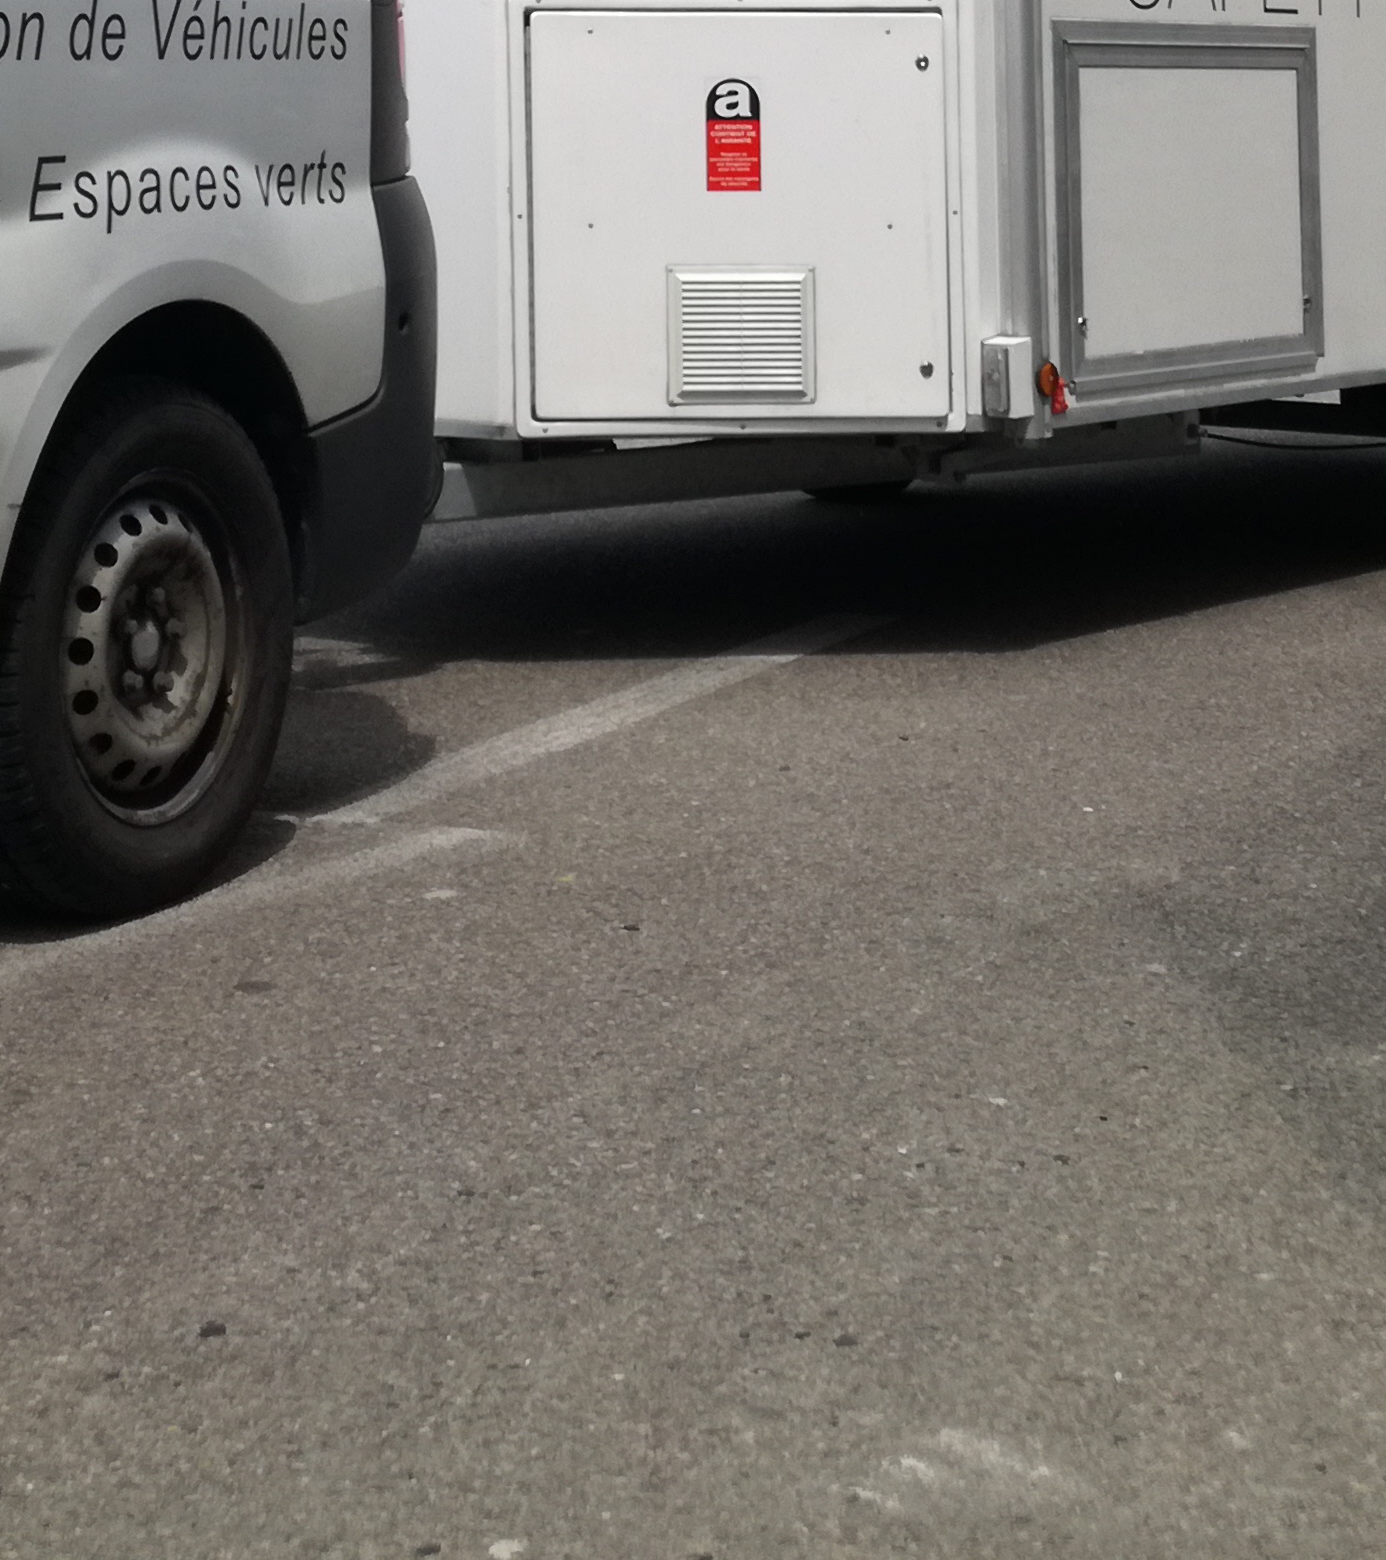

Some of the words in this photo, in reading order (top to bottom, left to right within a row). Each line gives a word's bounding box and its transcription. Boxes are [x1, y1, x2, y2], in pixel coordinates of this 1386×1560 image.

[152, 0, 349, 62] Véhicules
[28, 155, 242, 234] Espaces
[255, 150, 348, 208] verts
